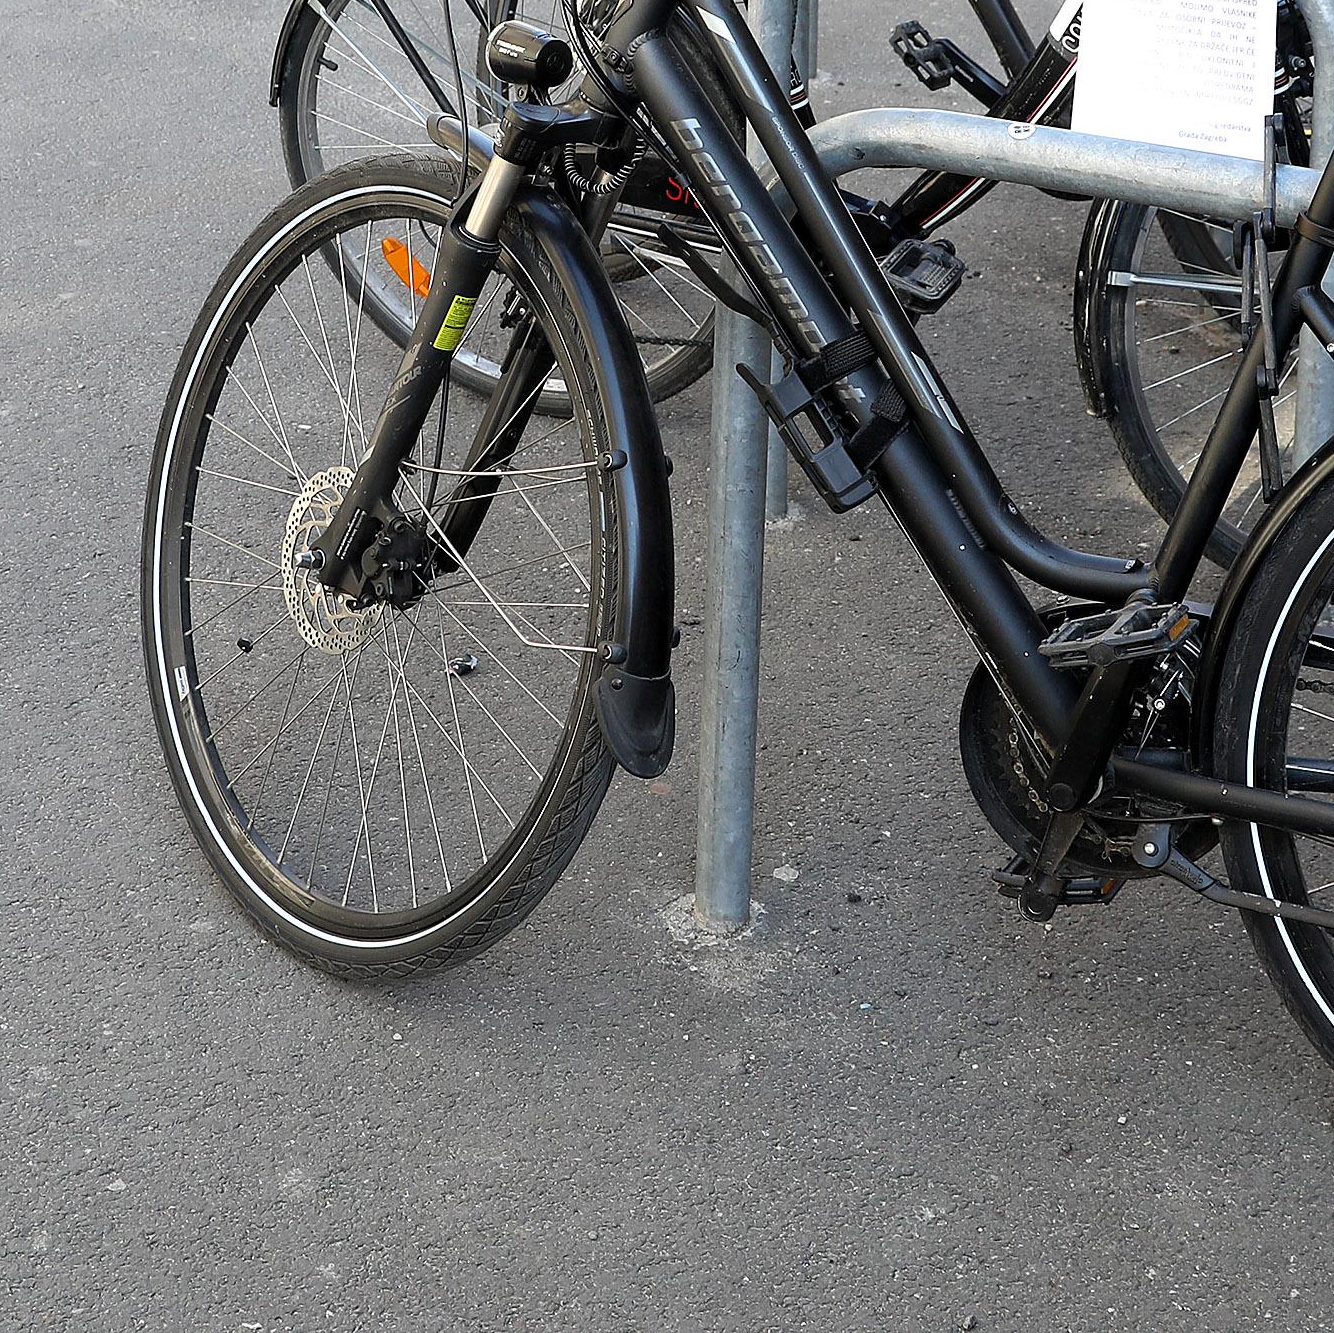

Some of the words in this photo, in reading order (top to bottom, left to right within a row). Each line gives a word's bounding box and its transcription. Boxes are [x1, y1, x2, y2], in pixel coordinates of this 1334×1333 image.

[1180, 1, 1215, 13] MOLIMO
[1221, 7, 1258, 20] VLASNIKE
[670, 117, 867, 403] bergamot
